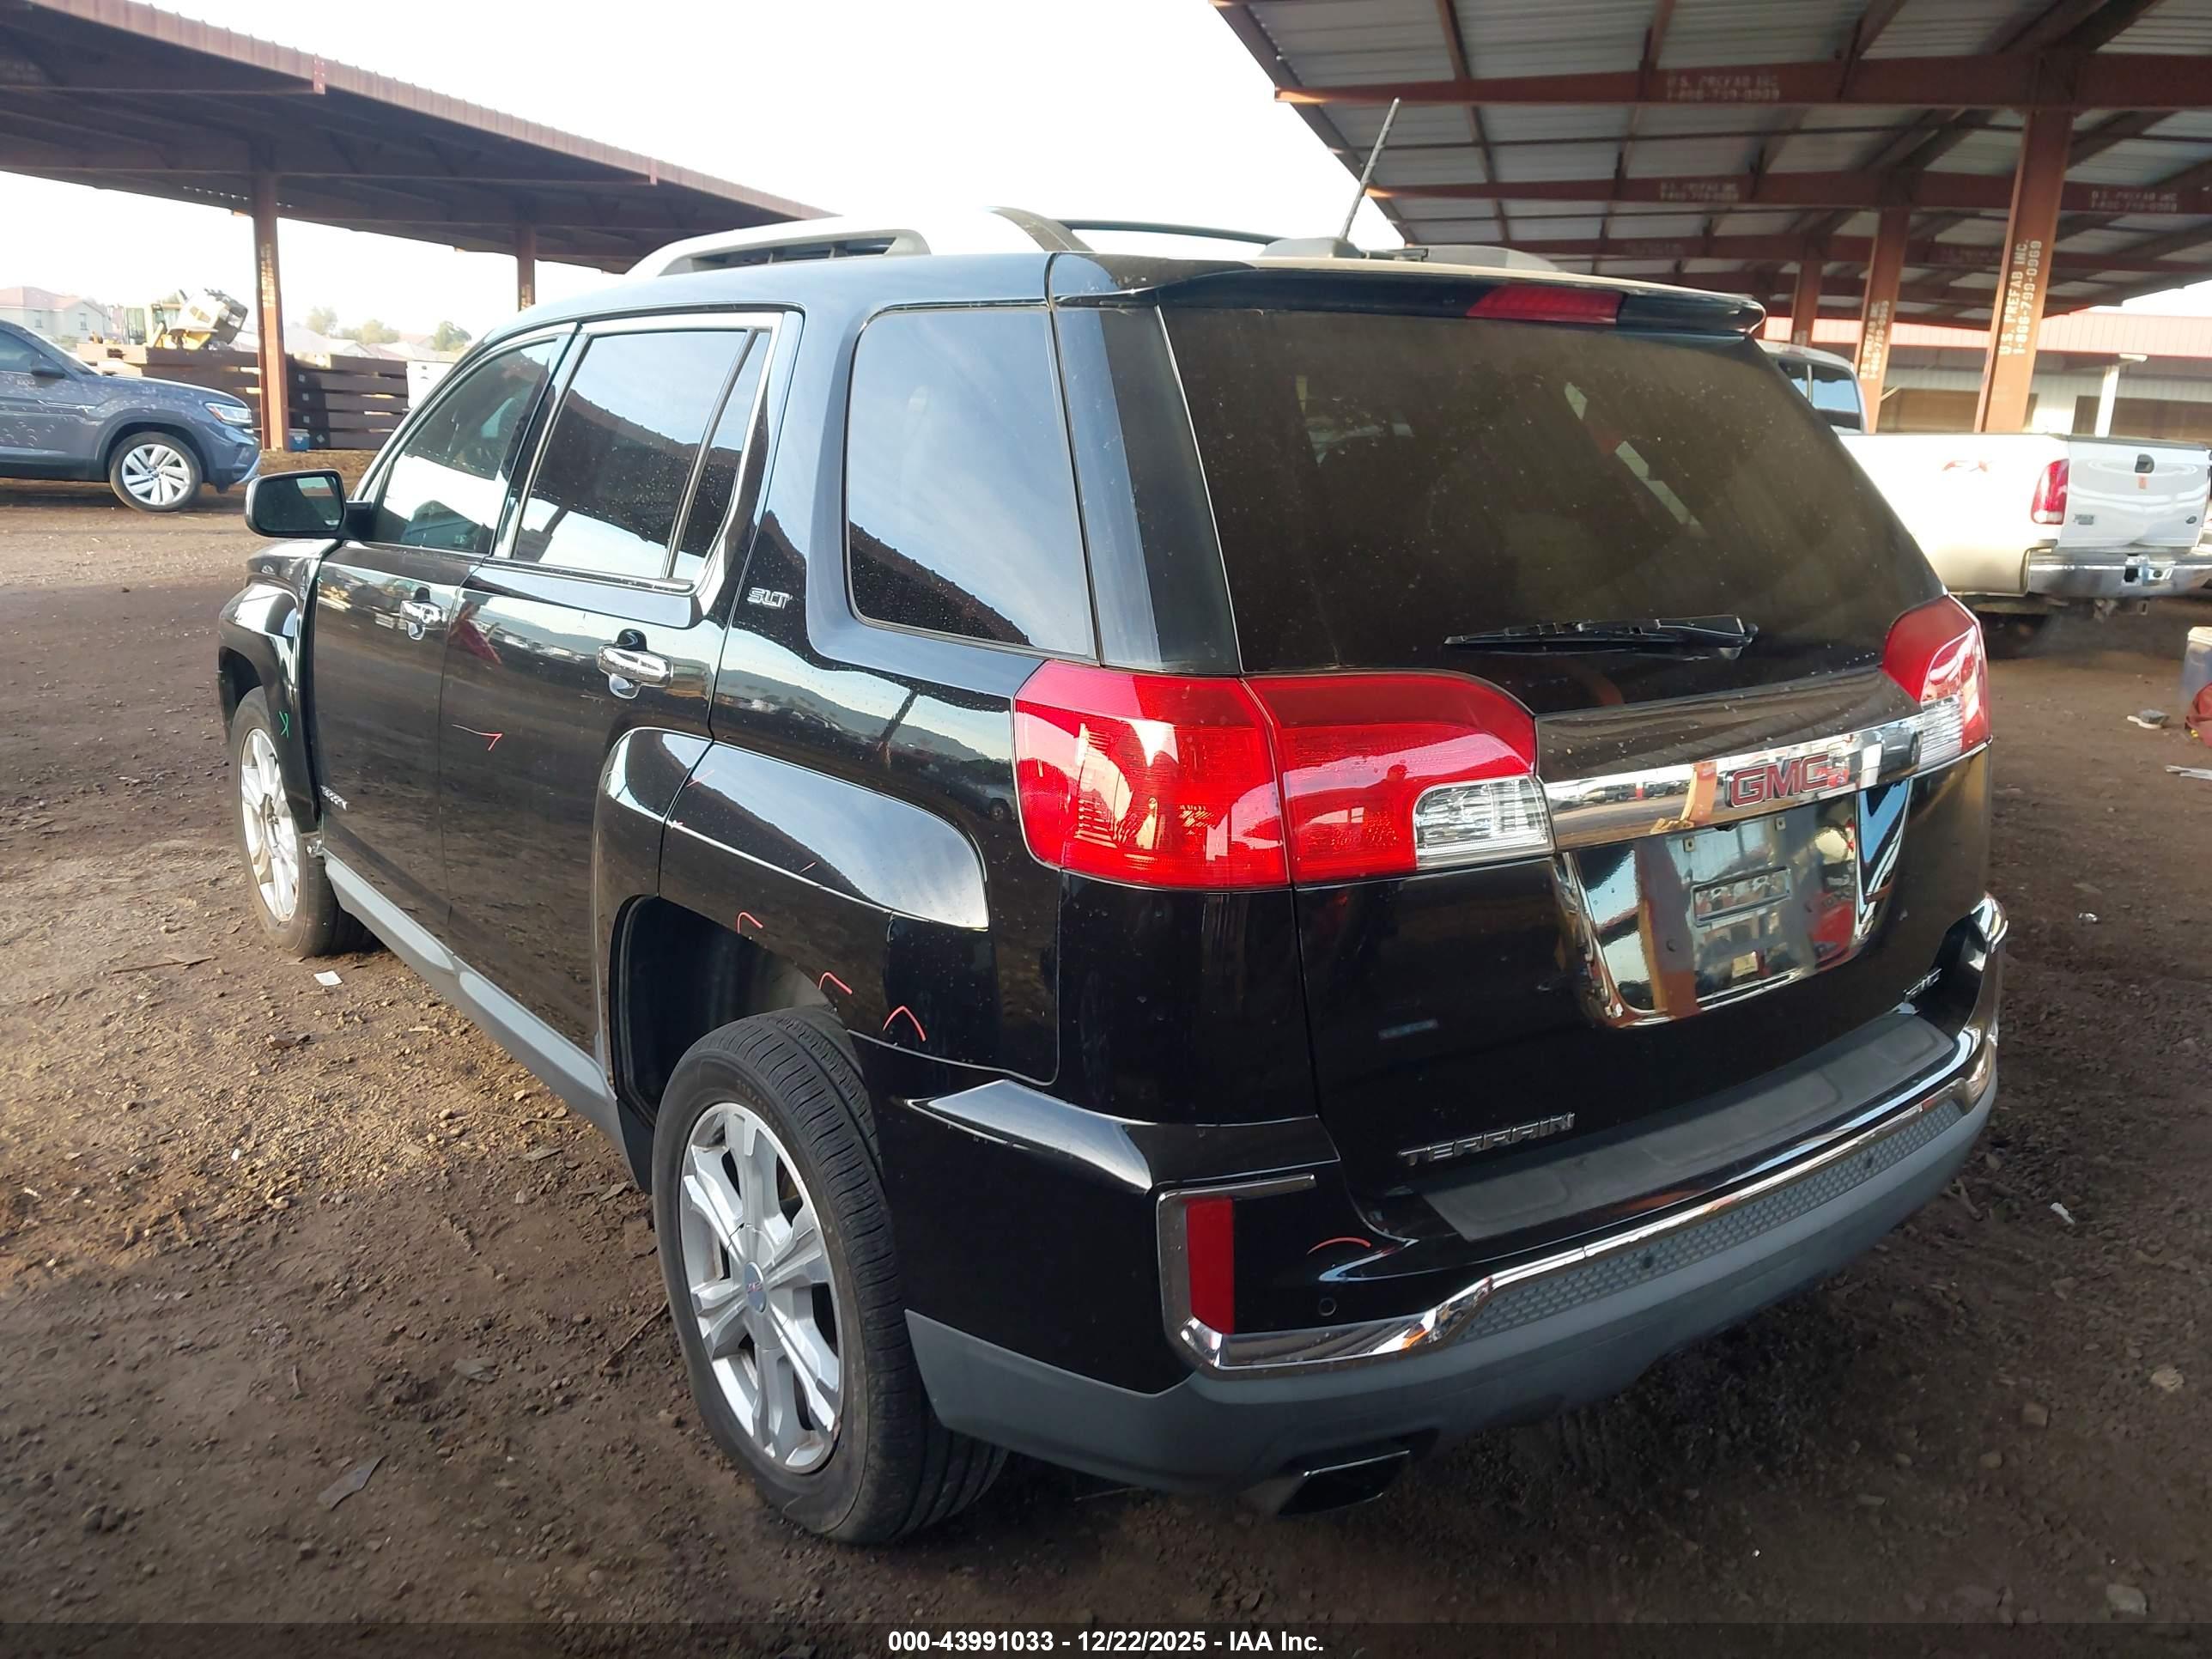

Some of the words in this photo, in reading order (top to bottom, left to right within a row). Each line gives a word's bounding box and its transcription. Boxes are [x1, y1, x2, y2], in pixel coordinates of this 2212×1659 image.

[2003, 270, 2023, 323] PREFAB
[747, 586, 793, 610] SLT
[1729, 750, 1830, 809] GMC
[1397, 1110, 1577, 1167] TERRAIN
